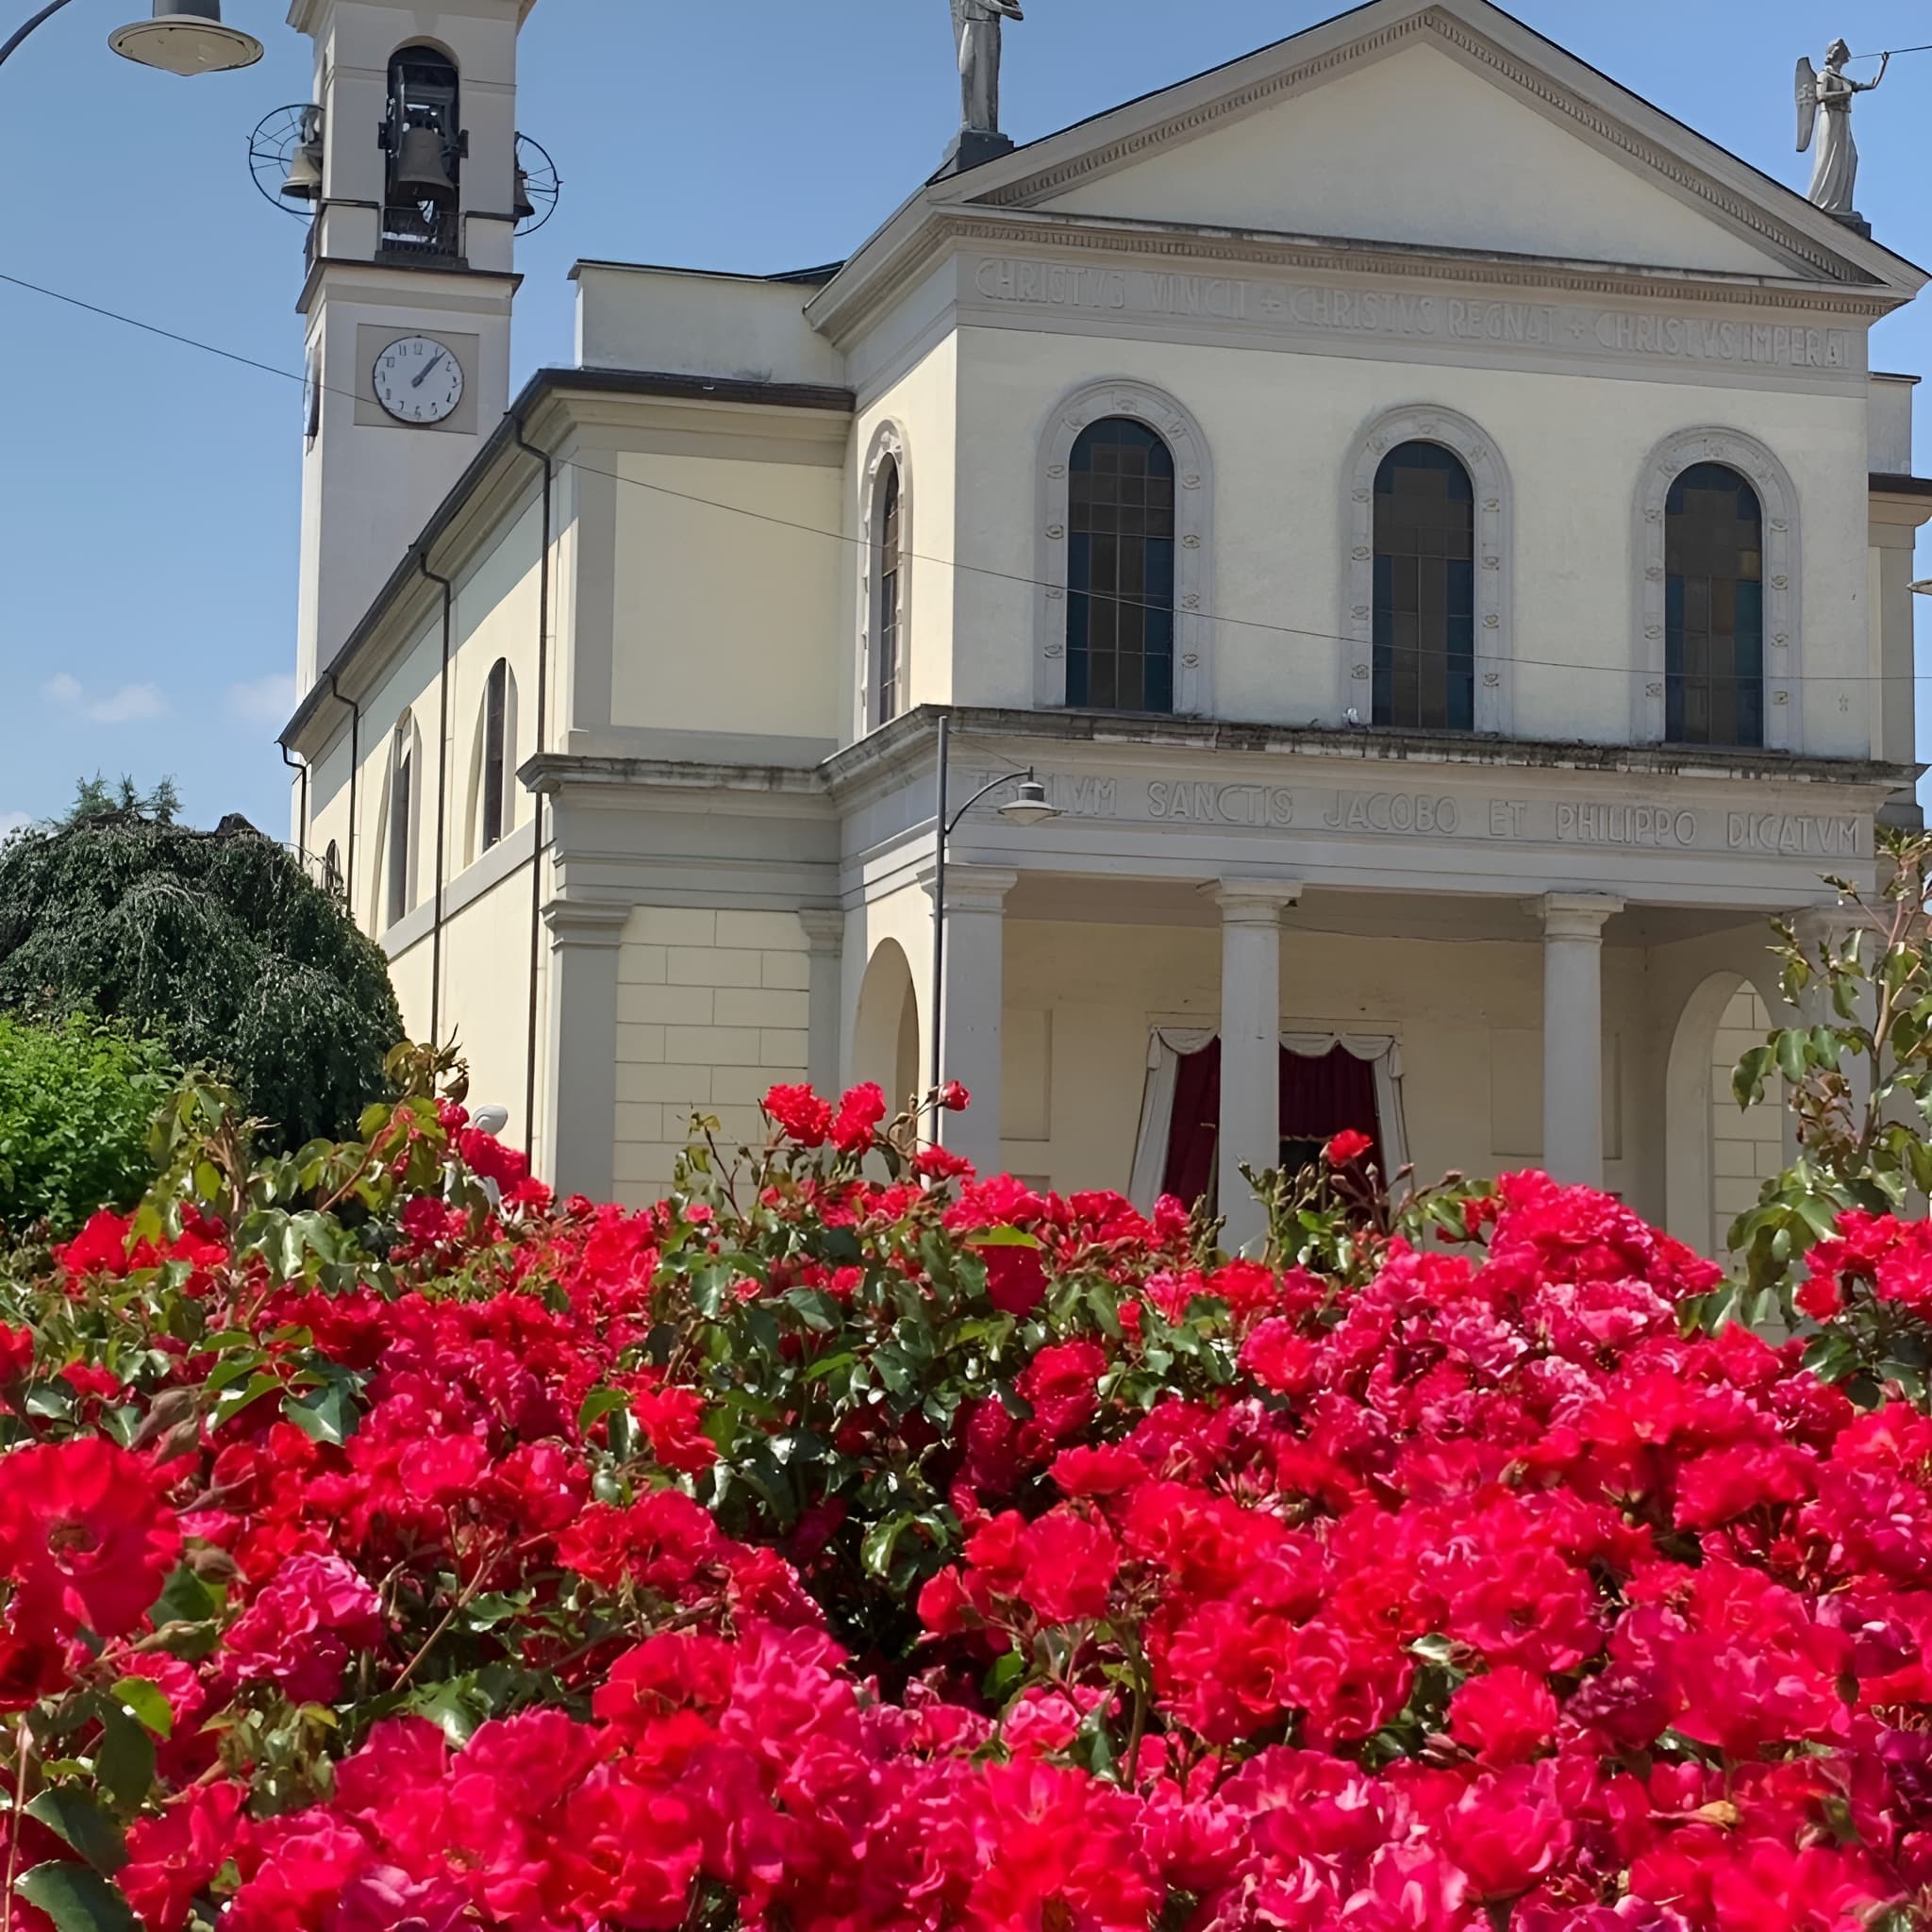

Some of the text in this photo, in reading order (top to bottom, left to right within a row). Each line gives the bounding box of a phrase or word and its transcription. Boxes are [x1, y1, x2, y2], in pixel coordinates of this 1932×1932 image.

[1147, 780, 1293, 824] SANCTIS
[1323, 791, 1458, 834] JACOBO
[1489, 799, 1527, 839] ET
[1556, 801, 1697, 846] PHILIPPO
[1726, 811, 1859, 854] DICATVM
